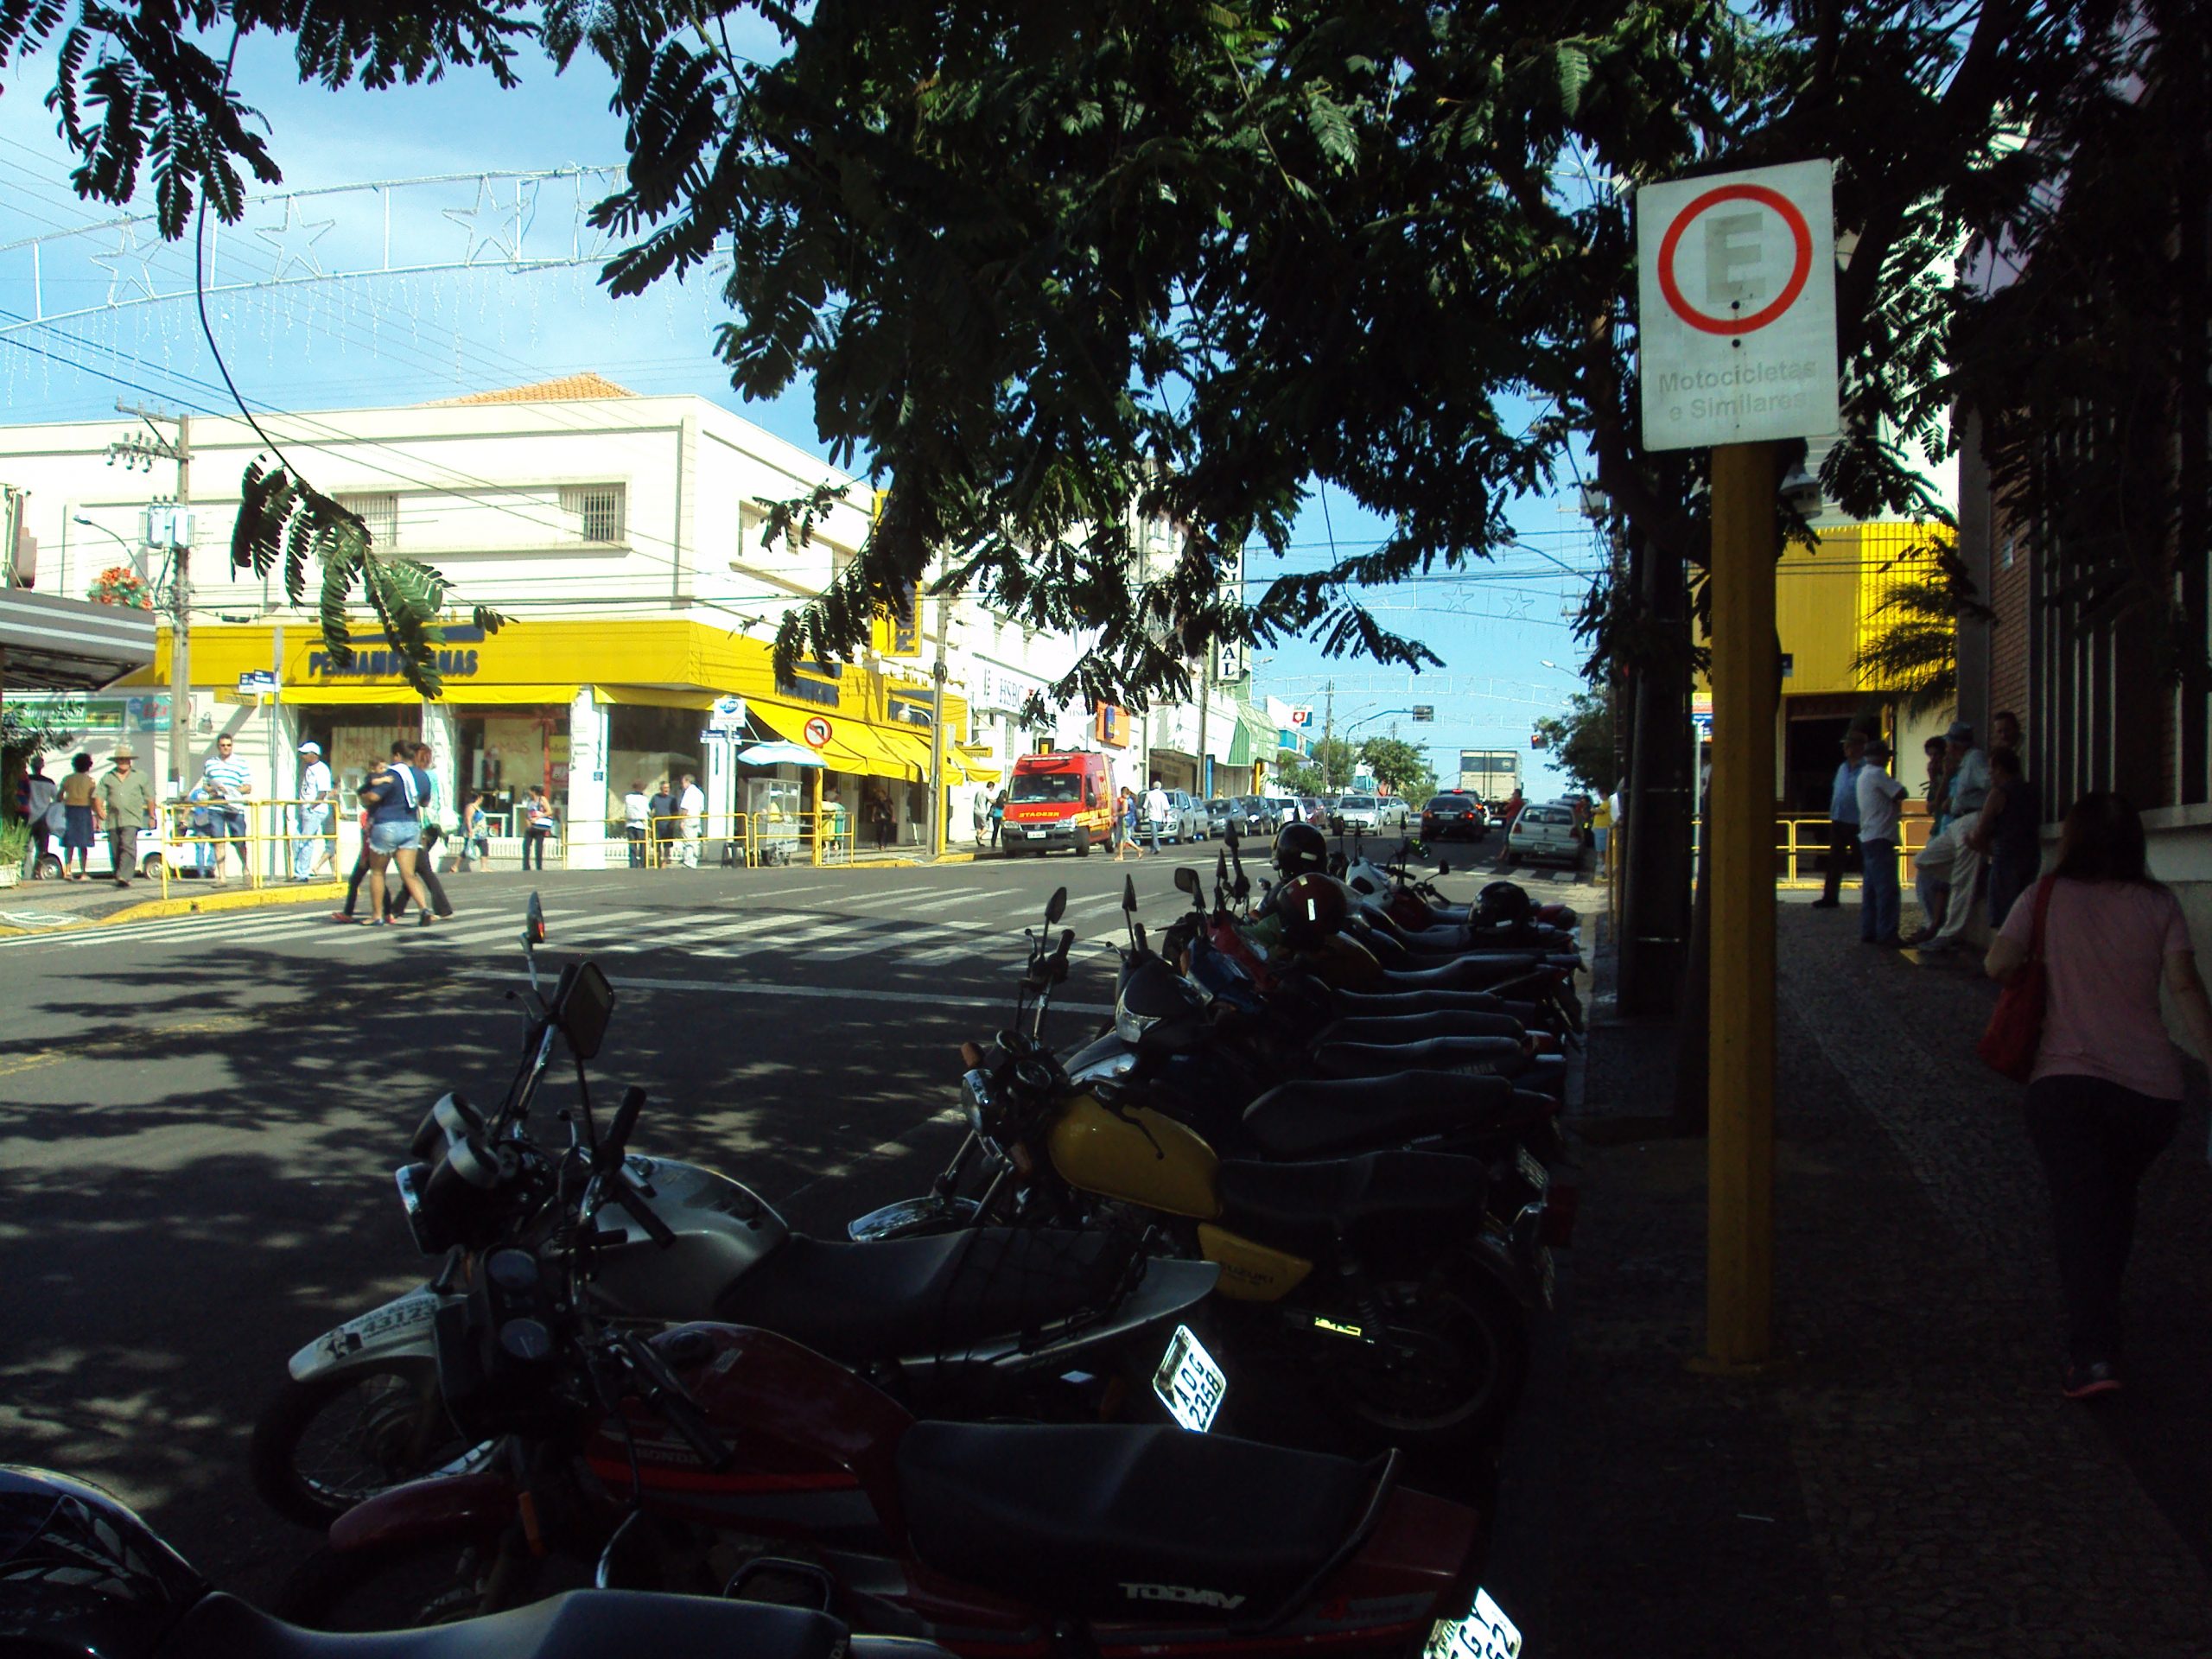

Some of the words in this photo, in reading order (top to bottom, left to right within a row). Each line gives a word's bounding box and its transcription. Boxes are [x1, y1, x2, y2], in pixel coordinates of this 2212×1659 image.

[1705, 212, 1764, 303] E
[1658, 361, 1816, 393] Motocicletas
[1669, 406, 1681, 421] e
[1691, 391, 1807, 419] Similares
[999, 677, 1024, 710] HSBC
[1189, 1370, 1220, 1431] 2358
[636, 1447, 703, 1465] HONDA
[1119, 1581, 1247, 1610] TODAY
